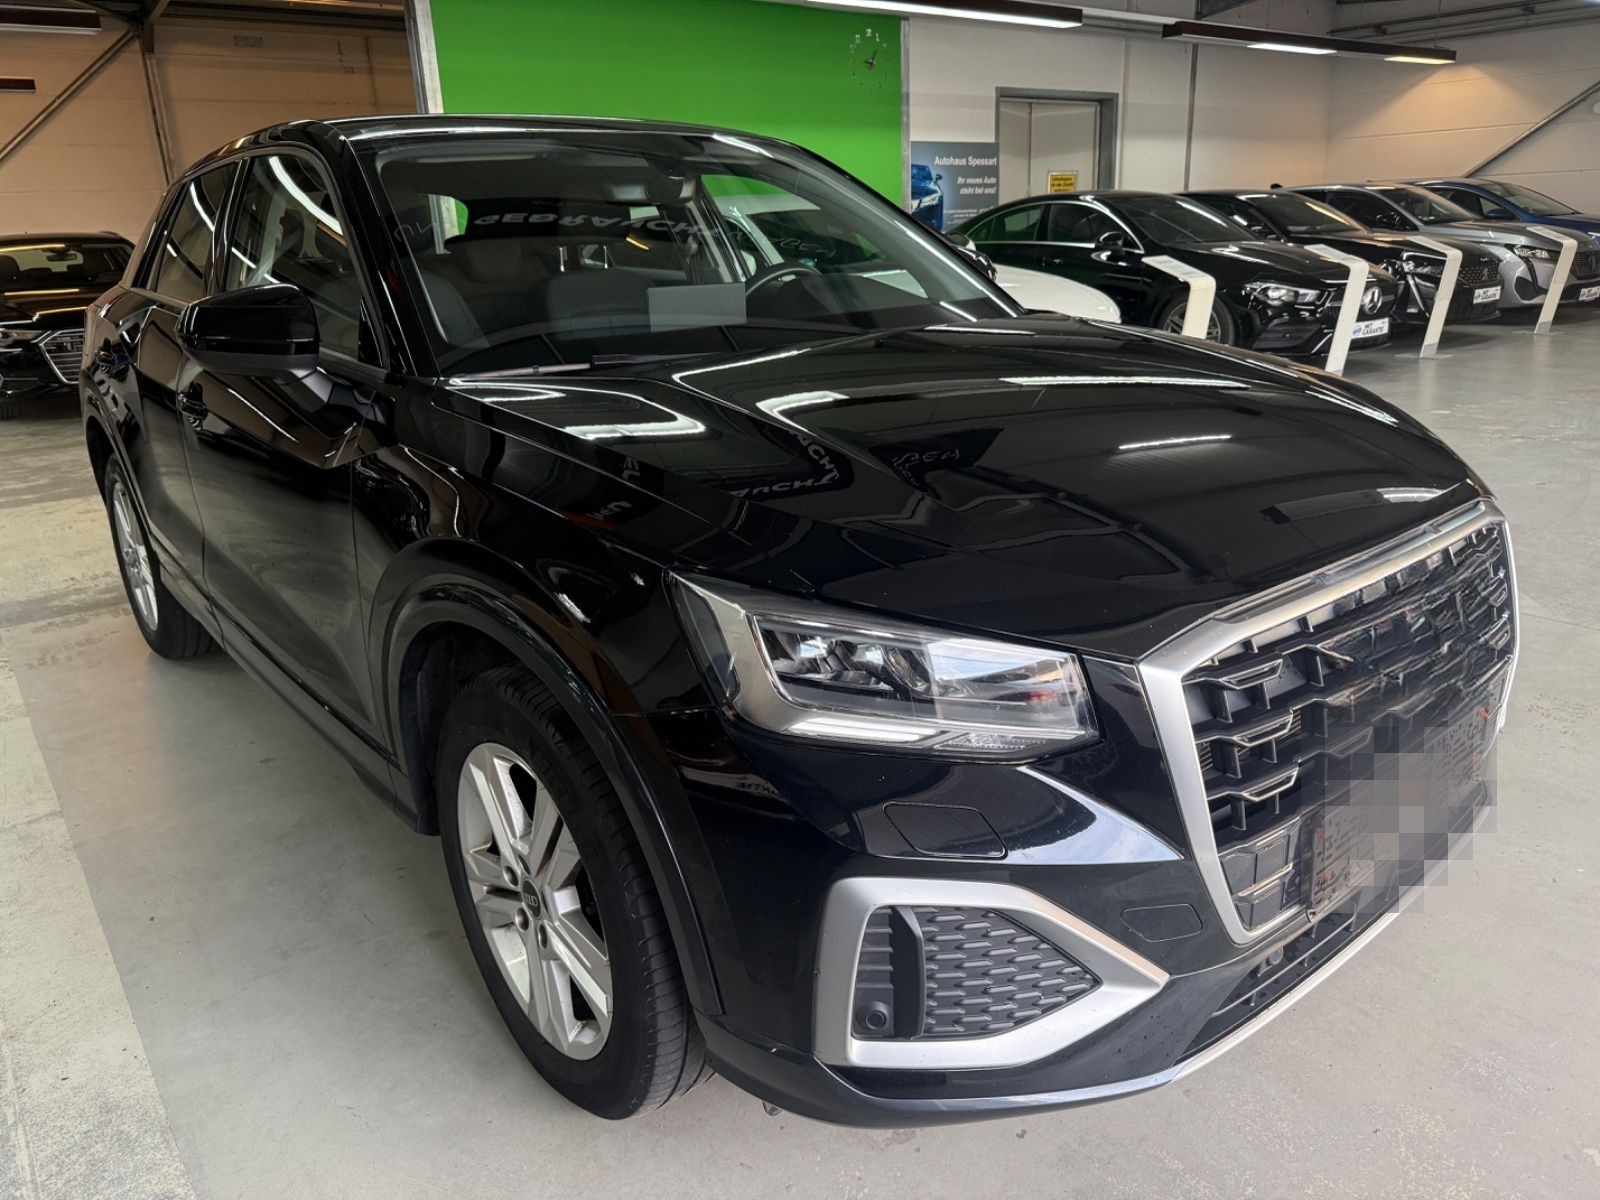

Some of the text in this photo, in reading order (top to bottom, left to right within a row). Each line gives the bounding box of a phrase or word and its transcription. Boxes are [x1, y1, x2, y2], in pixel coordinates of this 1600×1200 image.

[934, 156, 997, 167] Autohaus Spessart
[957, 176, 966, 185] Ihr
[984, 176, 997, 184] Auto
